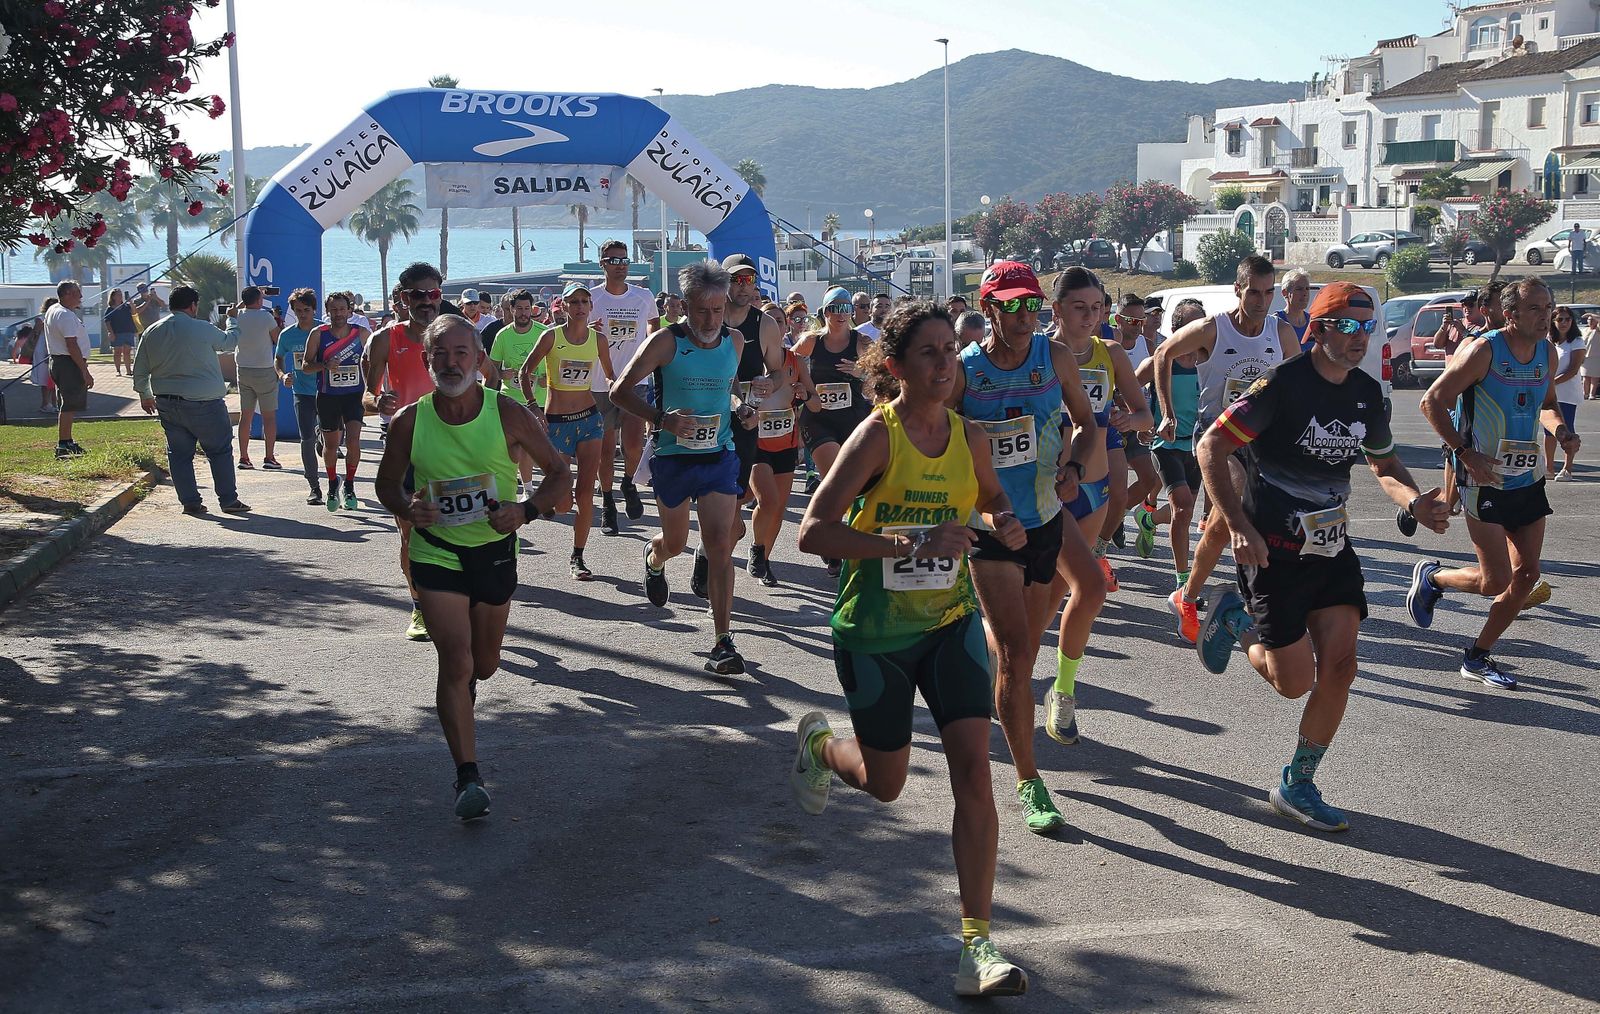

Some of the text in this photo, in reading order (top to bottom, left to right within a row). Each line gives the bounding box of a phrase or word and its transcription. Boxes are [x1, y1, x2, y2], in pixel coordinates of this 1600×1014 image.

[440, 91, 600, 117] BROOKS
[288, 122, 379, 193] DEPORTES
[660, 130, 742, 201] DEPORTES
[300, 134, 399, 210] ZULAICA
[646, 140, 732, 220] ZULAICA
[493, 176, 591, 194] SALIDA
[611, 326, 635, 336] 215
[333, 372, 356, 382] 255
[562, 368, 589, 380] 277
[820, 392, 848, 403] 334
[762, 418, 792, 431] 368
[1308, 447, 1358, 456] TRAIL
[1502, 453, 1537, 468] 189
[439, 489, 489, 515] 301
[904, 489, 949, 504] RUNNERS
[1312, 521, 1346, 546] 344
[893, 556, 954, 573] 245
